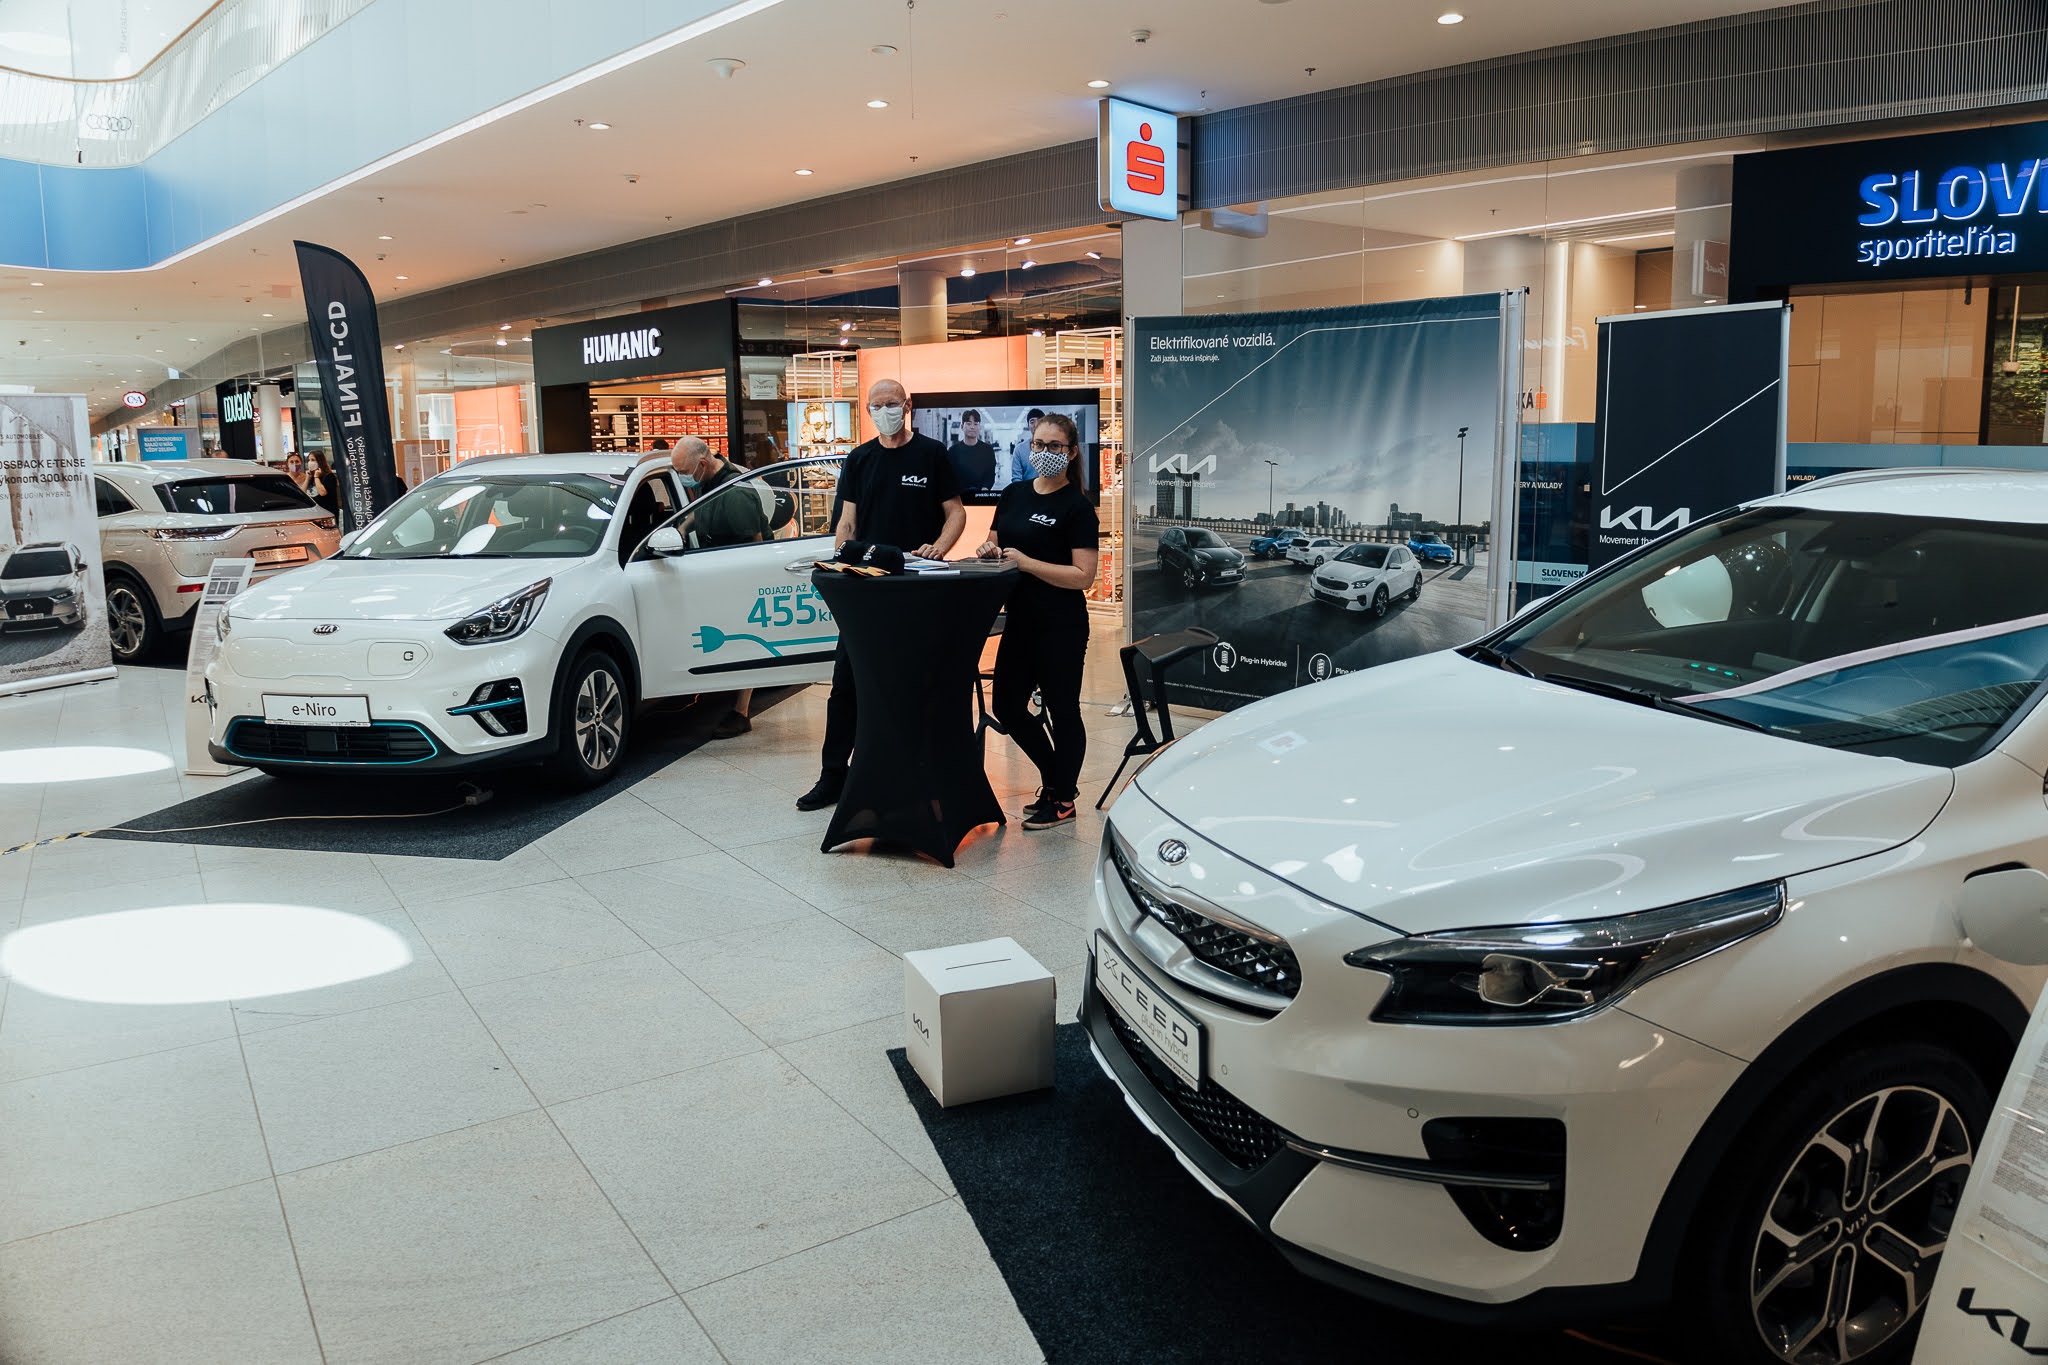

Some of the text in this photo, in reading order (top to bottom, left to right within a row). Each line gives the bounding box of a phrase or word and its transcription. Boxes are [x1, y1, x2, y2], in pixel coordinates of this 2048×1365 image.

[583, 327, 662, 365] HUMANIC
[1150, 332, 1276, 350] Elektrifikované vozidlá.
[223, 391, 253, 423] DOUGLAS
[47, 458, 86, 468] E-TENSE
[40, 473, 60, 482] 300
[1537, 482, 1563, 491] VKLADY
[1600, 535, 1639, 545] Movement
[758, 583, 808, 596] DOJAZD AŽ
[747, 593, 816, 628] 455
[1240, 656, 1260, 665] Plug-in
[292, 703, 337, 717] e-Niro
[1141, 1013, 1189, 1064] plug-in hybrid
